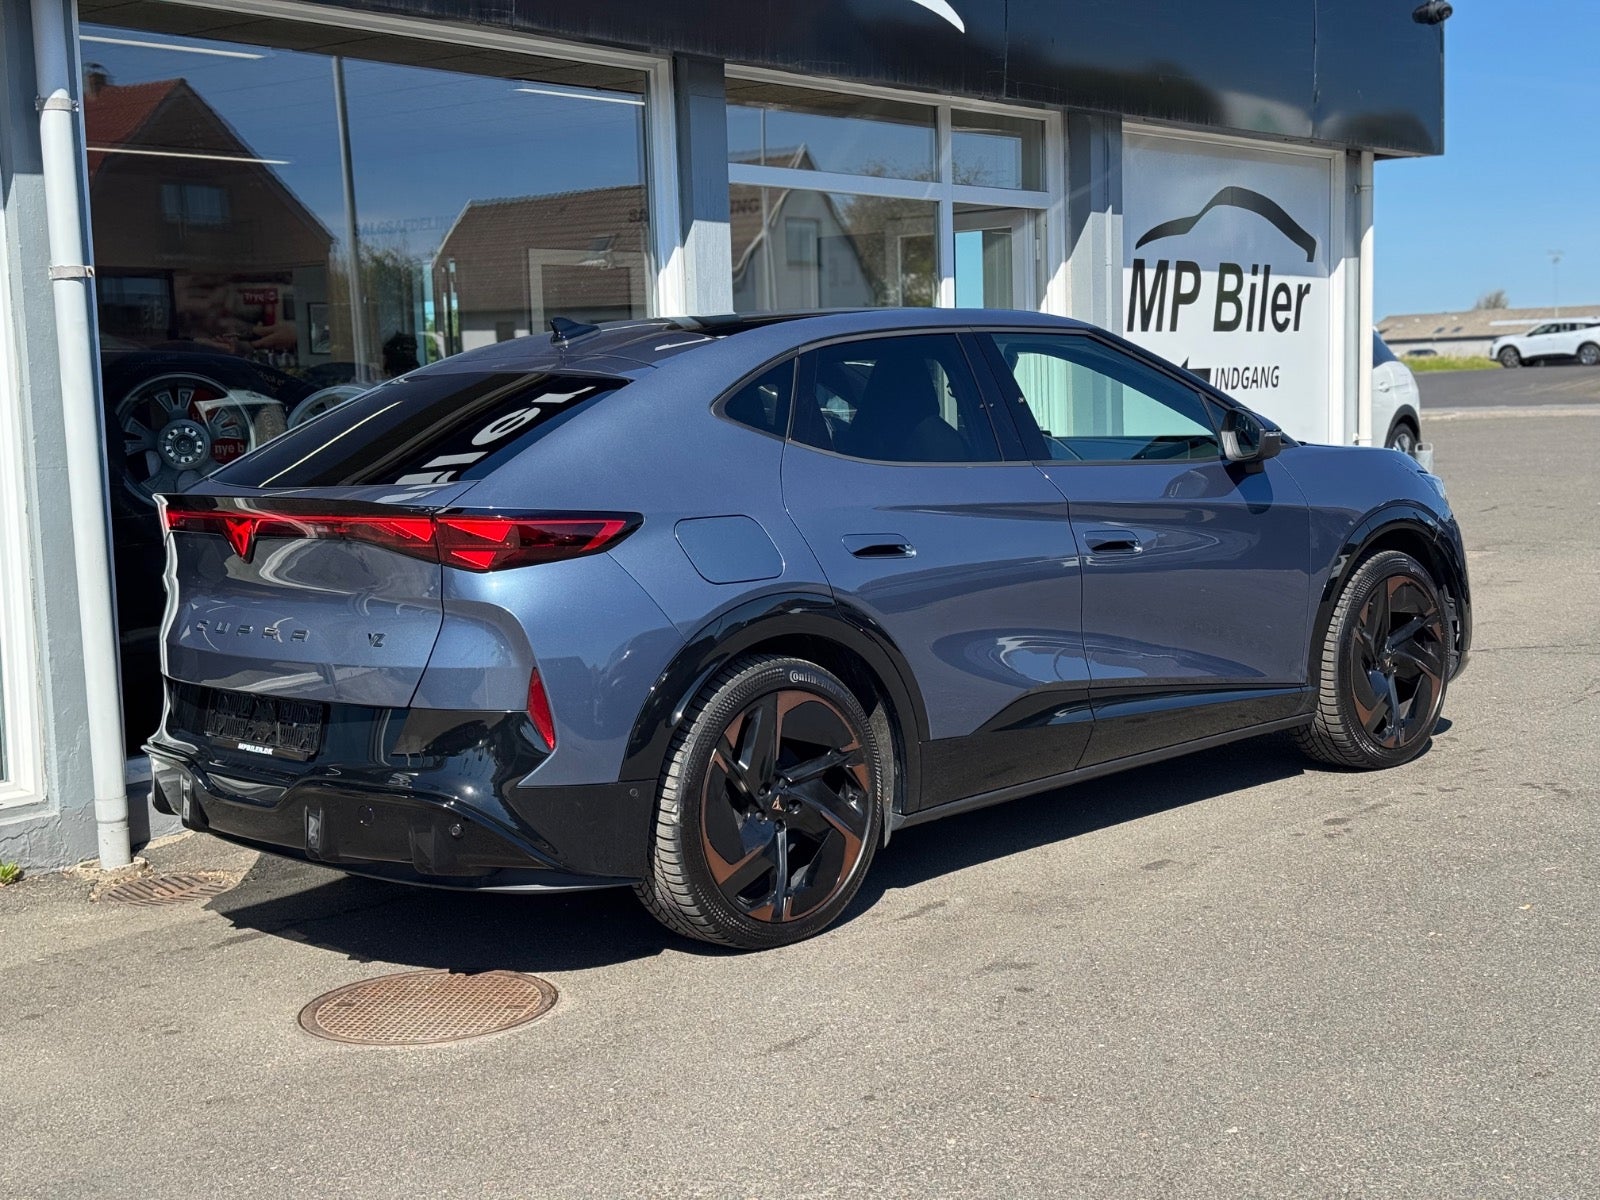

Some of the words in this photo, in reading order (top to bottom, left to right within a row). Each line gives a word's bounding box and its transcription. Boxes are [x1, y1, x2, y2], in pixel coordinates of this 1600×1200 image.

[1126, 258, 1202, 332] MP
[1212, 262, 1312, 333] Biler
[1215, 365, 1280, 390] INDGANG
[214, 443, 235, 457] nye
[196, 619, 311, 643] CUPRA
[367, 632, 386, 648] VZ
